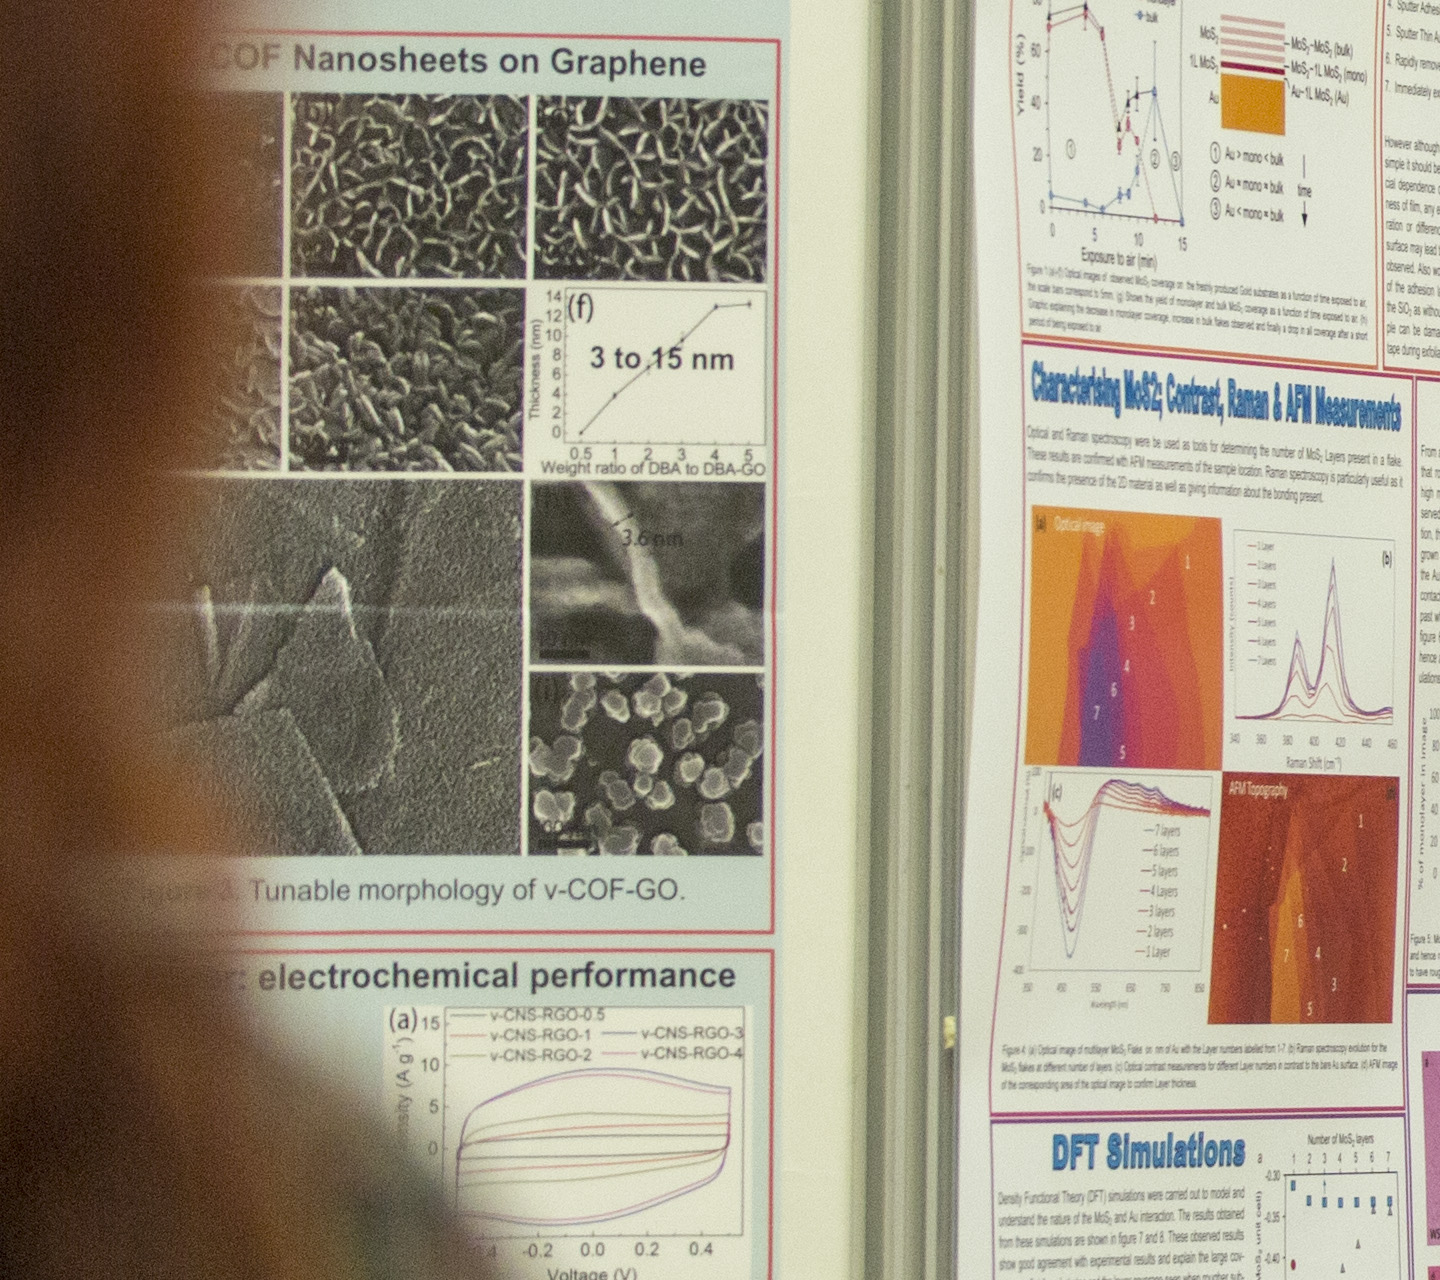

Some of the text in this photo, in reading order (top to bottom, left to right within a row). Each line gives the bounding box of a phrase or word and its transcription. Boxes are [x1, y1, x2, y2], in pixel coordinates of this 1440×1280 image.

[293, 42, 489, 74] Nanosheets
[498, 52, 540, 74] on
[550, 45, 707, 82] Graphene
[567, 292, 594, 323] (f)
[590, 346, 734, 370] 3 to 15 nm
[1031, 360, 1122, 417] Characterising
[1165, 371, 1224, 418] Contrast,
[1227, 376, 1270, 420] Raman
[1272, 381, 1283, 421] &
[1285, 382, 1312, 423] AFM
[1315, 385, 1402, 431] Measurements
[540, 461, 766, 477] Weight ratio of DBA to DBA-GO
[247, 876, 685, 906] Tunable morphology of v-COF-GO.
[258, 960, 737, 996] electrochemical performance
[389, 1007, 418, 1034] (a)
[1052, 1131, 1246, 1171] DFT Simulations
